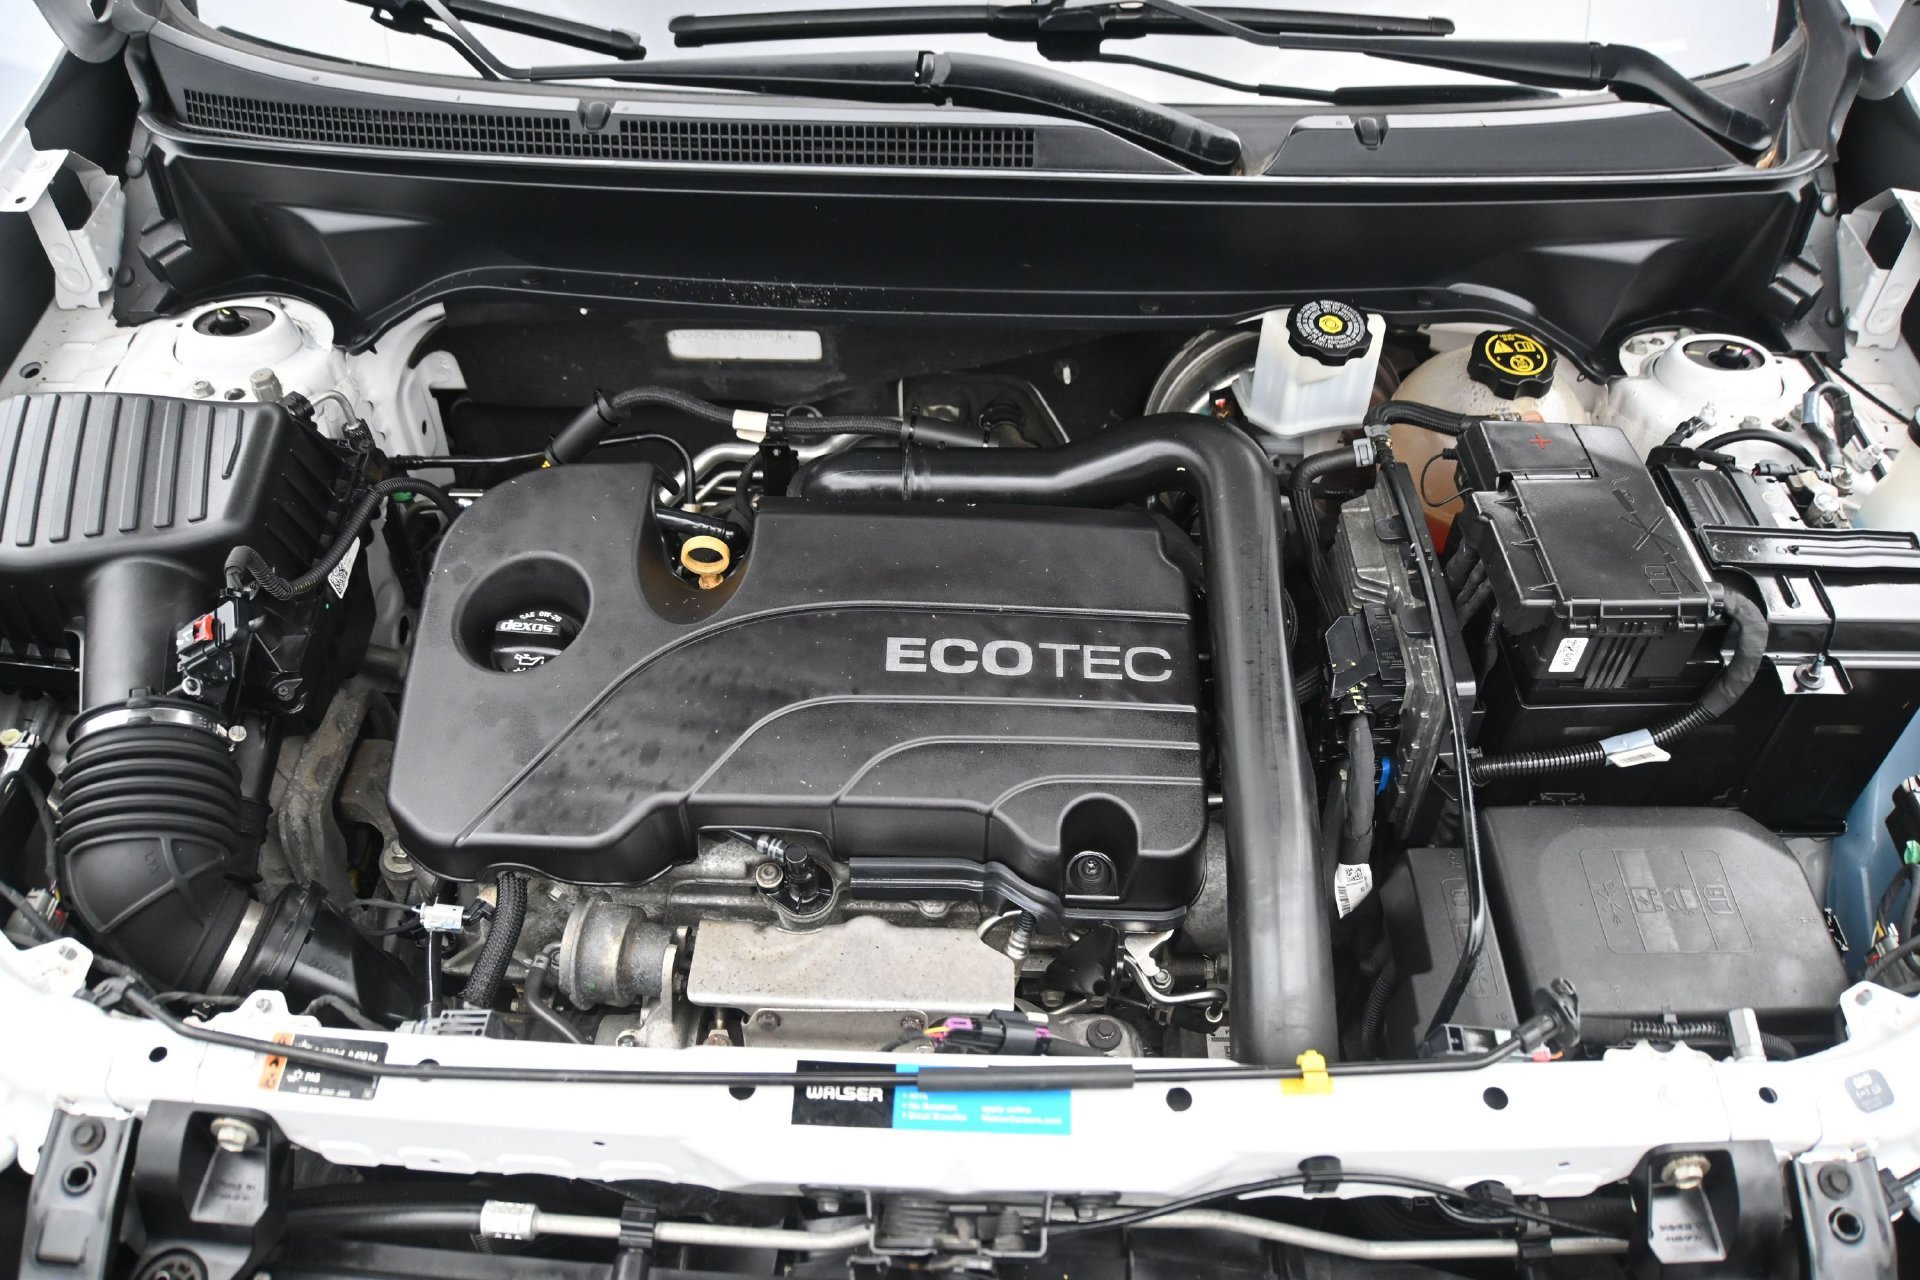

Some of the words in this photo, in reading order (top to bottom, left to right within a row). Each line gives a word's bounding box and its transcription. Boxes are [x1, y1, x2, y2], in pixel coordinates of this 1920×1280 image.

[519, 612, 535, 620] SAE
[539, 611, 562, 622] 0W-20
[500, 619, 556, 634] dexos
[885, 636, 1173, 682] ECOTEC
[805, 1085, 884, 1102] WALSER
